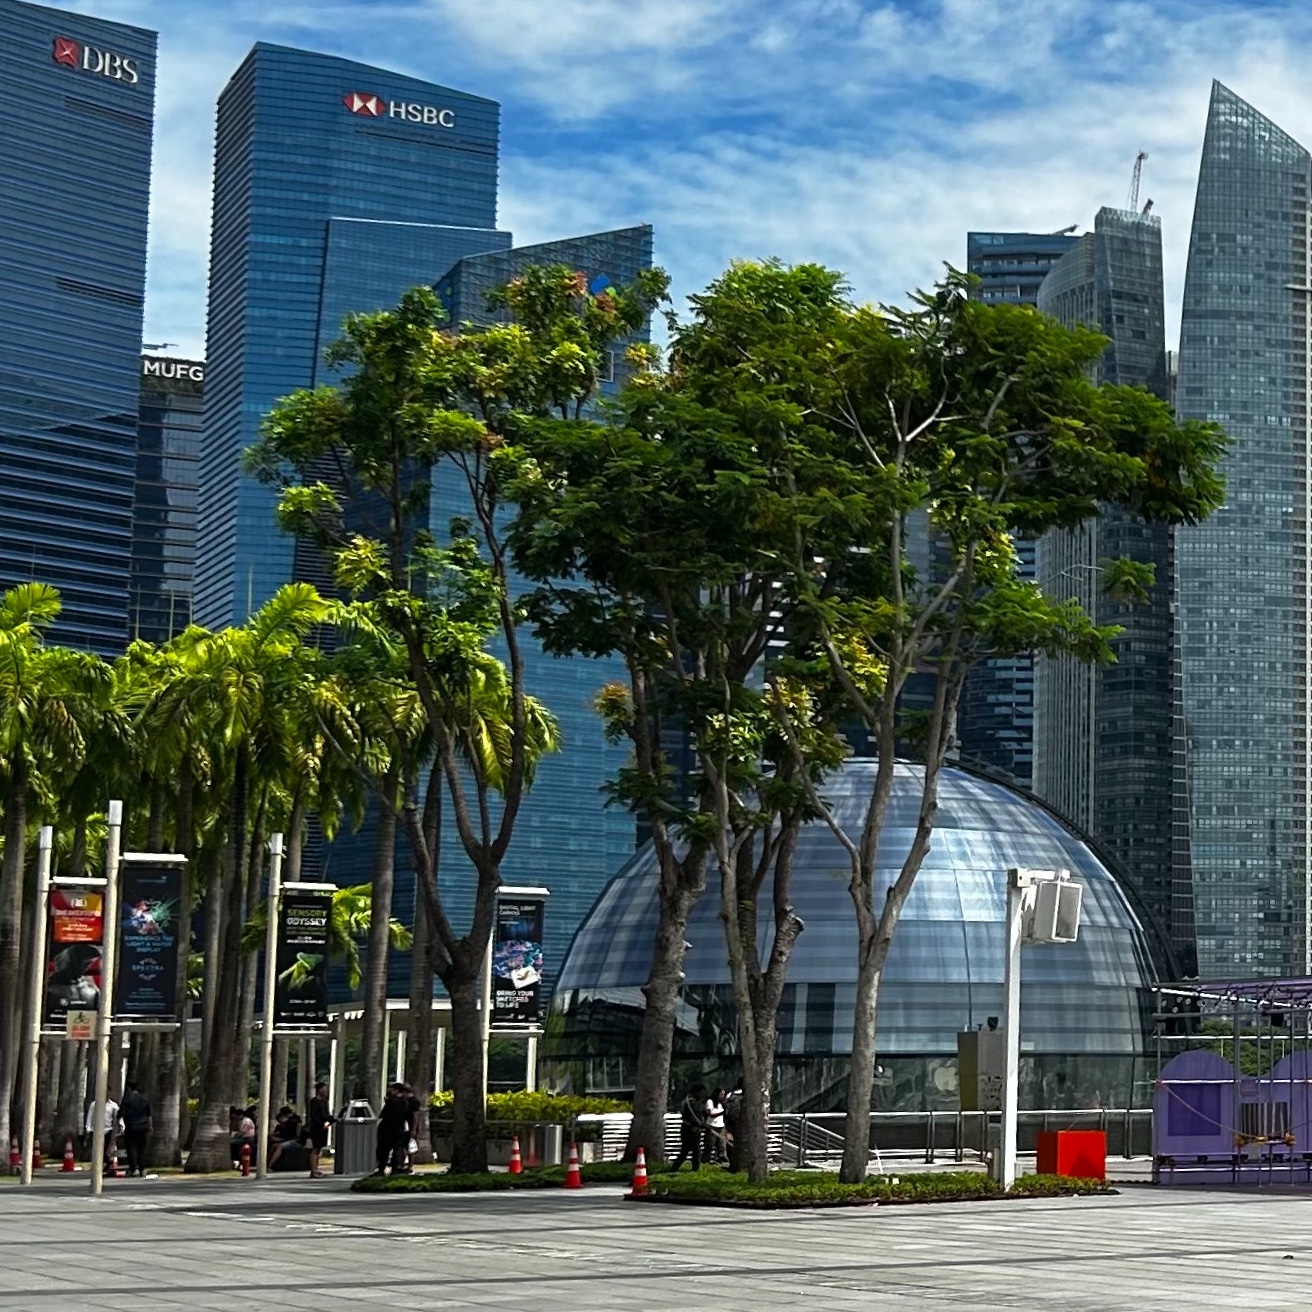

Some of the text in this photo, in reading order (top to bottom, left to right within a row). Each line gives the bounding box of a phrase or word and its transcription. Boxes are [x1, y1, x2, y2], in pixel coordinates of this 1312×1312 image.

[82, 45, 139, 84] DBS
[389, 100, 455, 128] HSBC
[143, 360, 204, 382] MUFG
[286, 917, 327, 926] ODYSSEY
